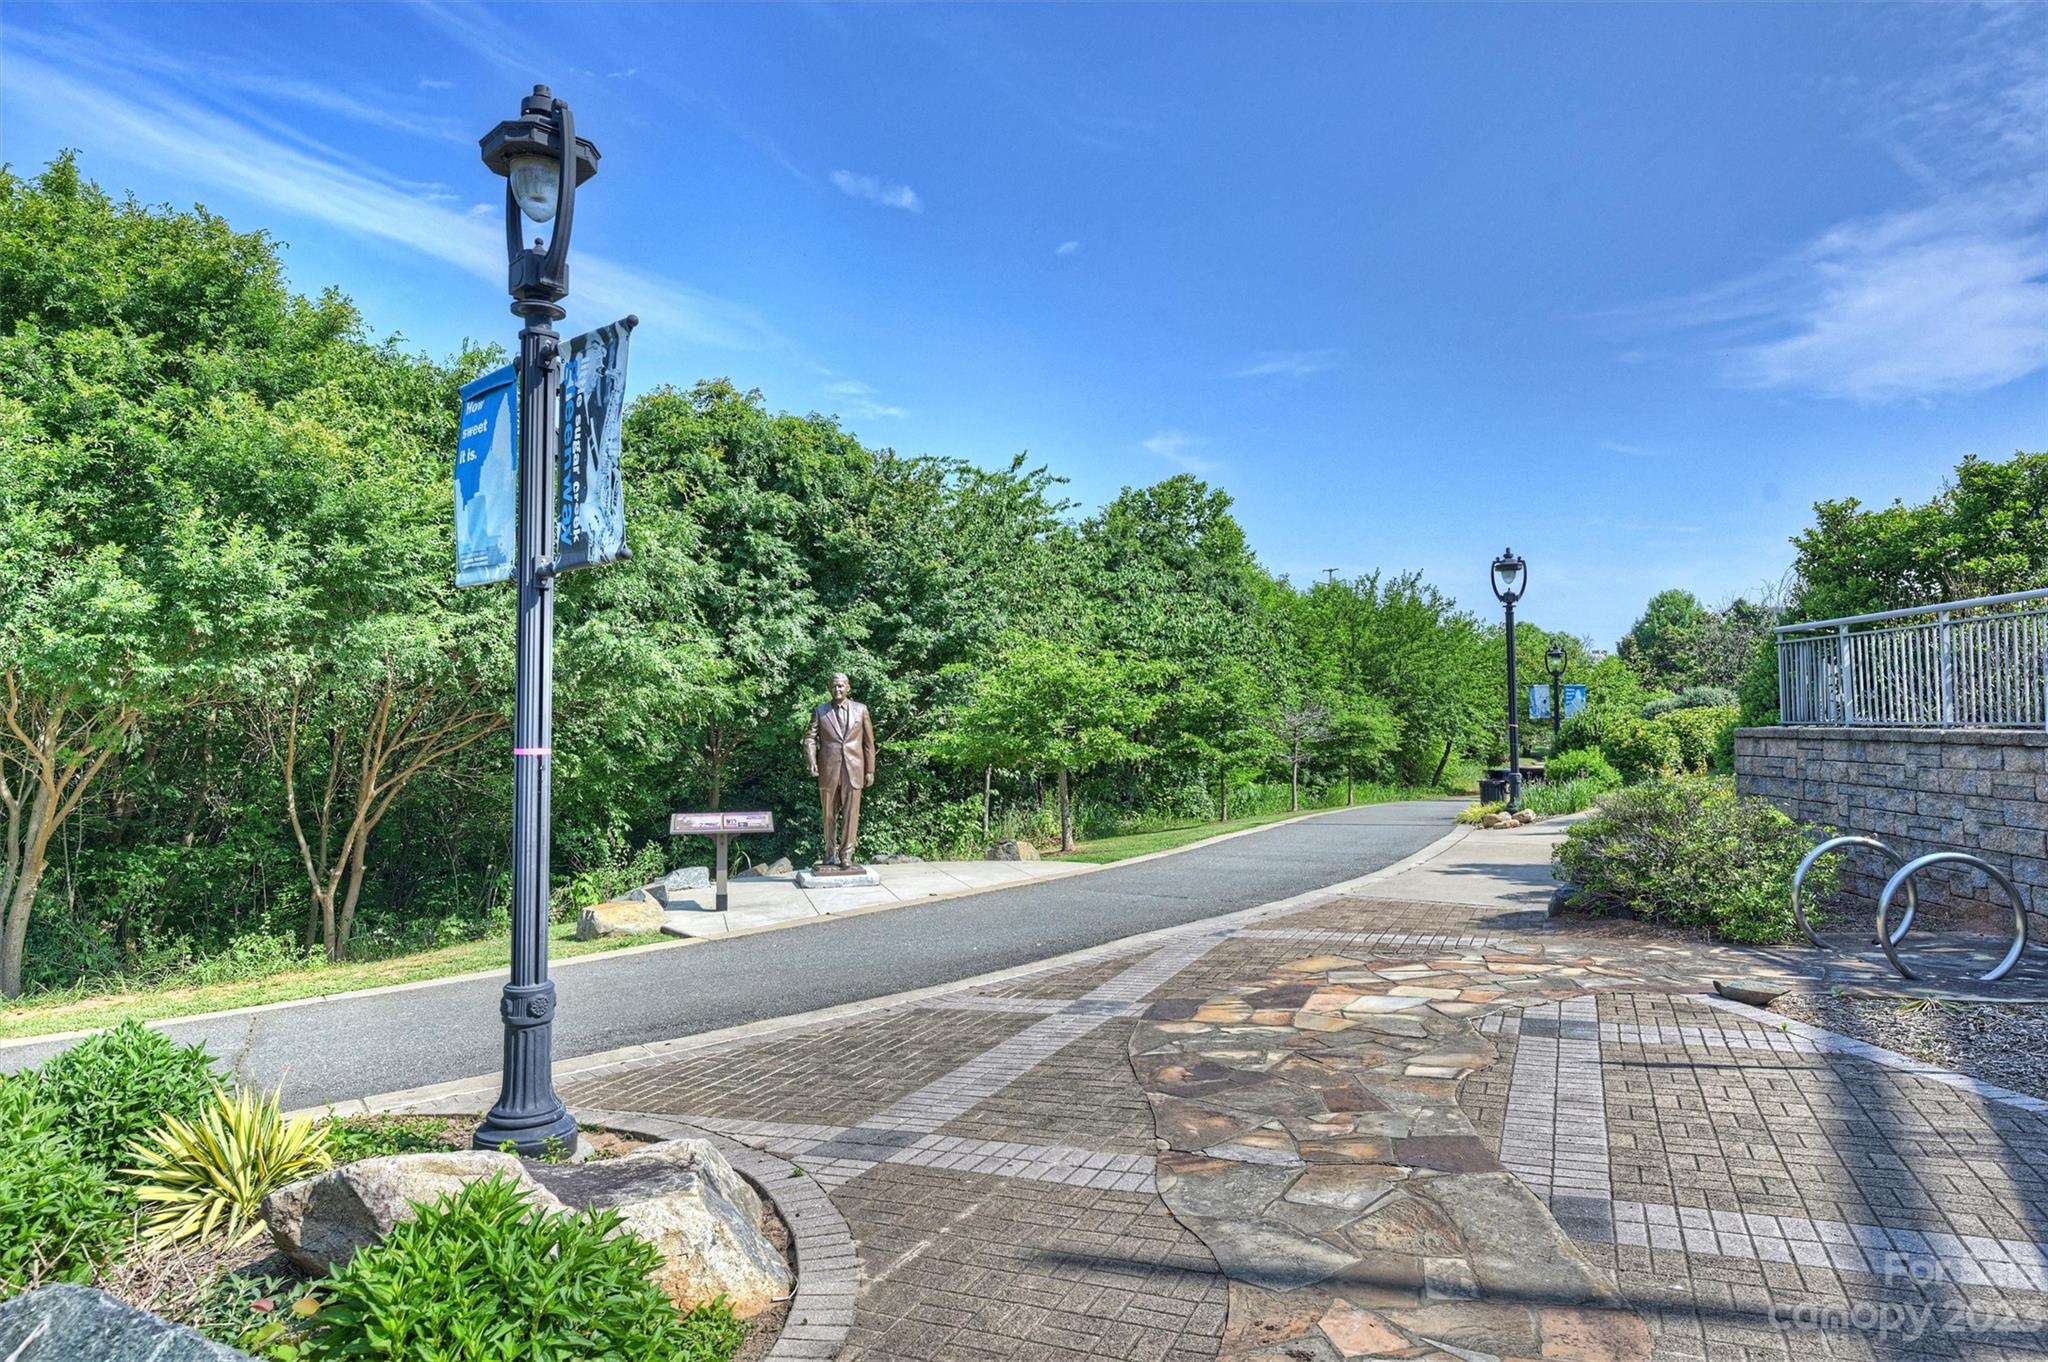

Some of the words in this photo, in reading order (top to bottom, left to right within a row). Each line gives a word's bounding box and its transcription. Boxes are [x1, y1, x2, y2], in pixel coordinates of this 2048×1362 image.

[466, 399, 486, 416] How
[462, 418, 488, 440] sweet
[572, 414, 582, 474] sugar
[459, 449, 466, 465] it
[466, 447, 478, 462] is.
[572, 481, 581, 542] creek
